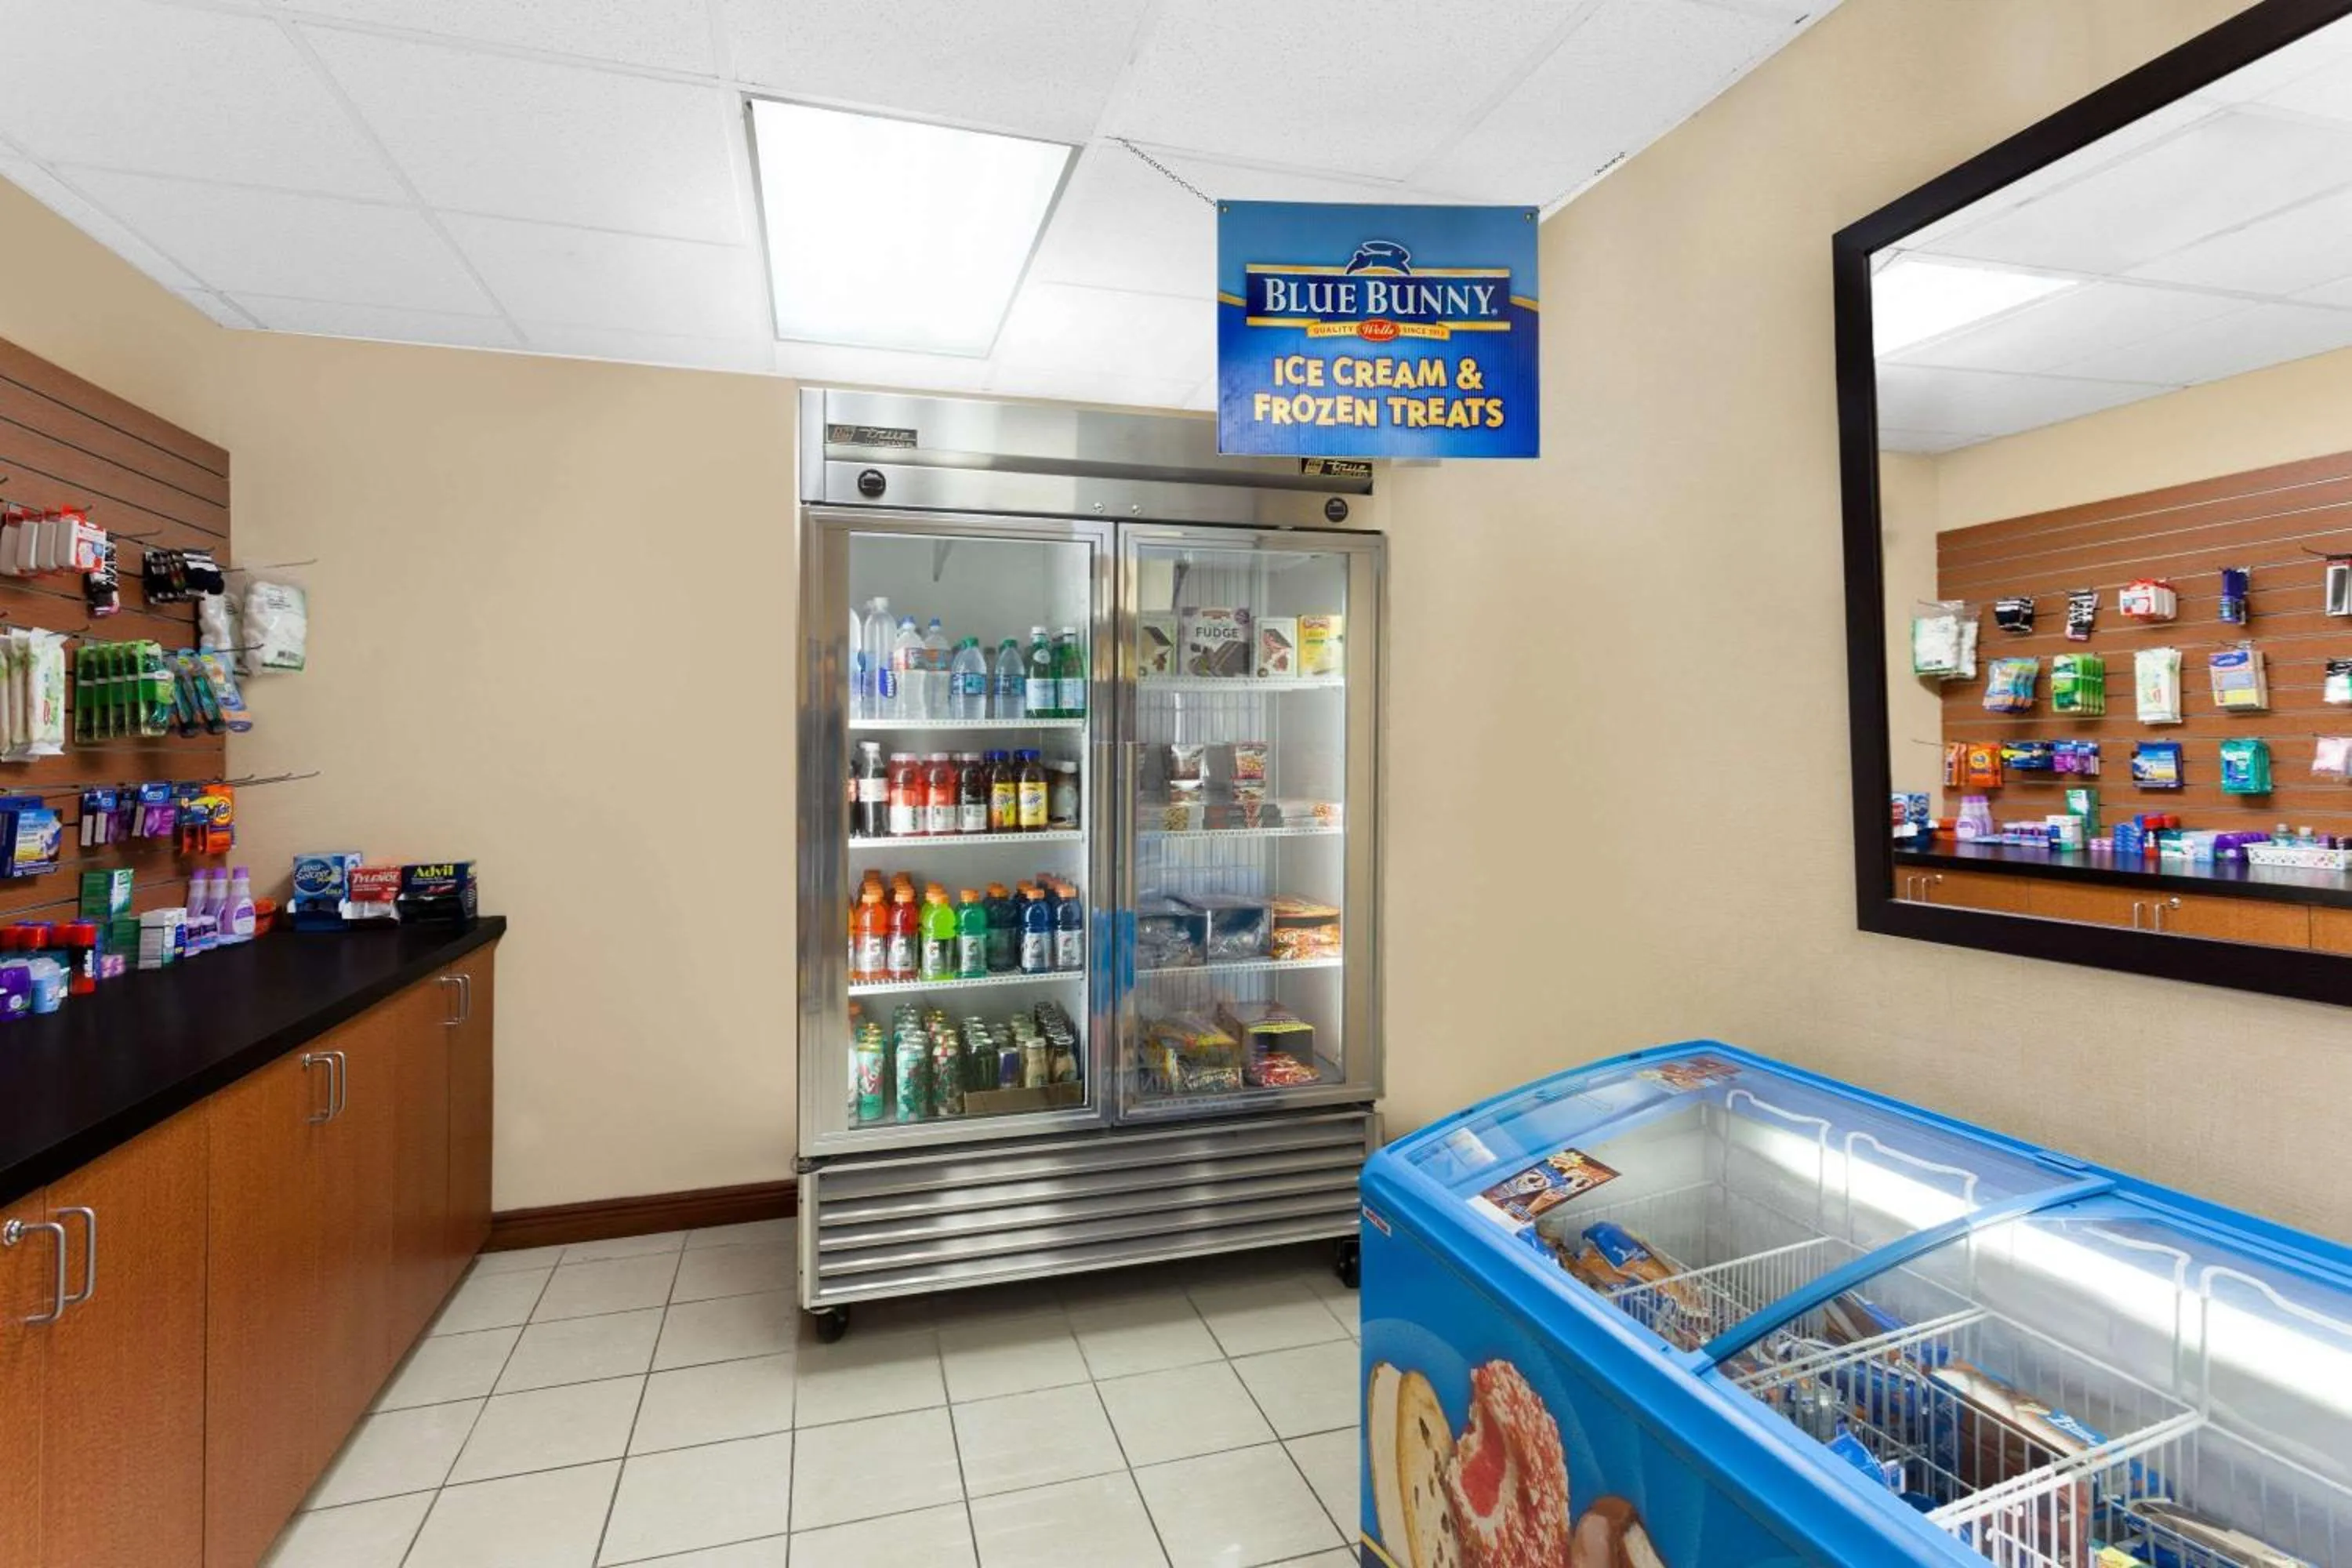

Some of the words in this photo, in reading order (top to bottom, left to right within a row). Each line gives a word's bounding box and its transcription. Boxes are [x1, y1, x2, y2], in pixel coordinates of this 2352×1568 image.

[1264, 278, 1357, 314] BLUE
[1313, 325, 1354, 335] QUALITY
[1362, 322, 1395, 336] Wells
[1403, 326, 1426, 335] SINCE
[1274, 355, 1323, 387] ICE
[1333, 357, 1446, 389] CREAM
[1456, 358, 1483, 390] &
[1254, 393, 1377, 427] FROZEN
[1387, 395, 1504, 428] TREATS
[1196, 626, 1240, 637] FUDGE
[414, 865, 454, 877] Advil
[352, 873, 400, 884] TYLENOL
